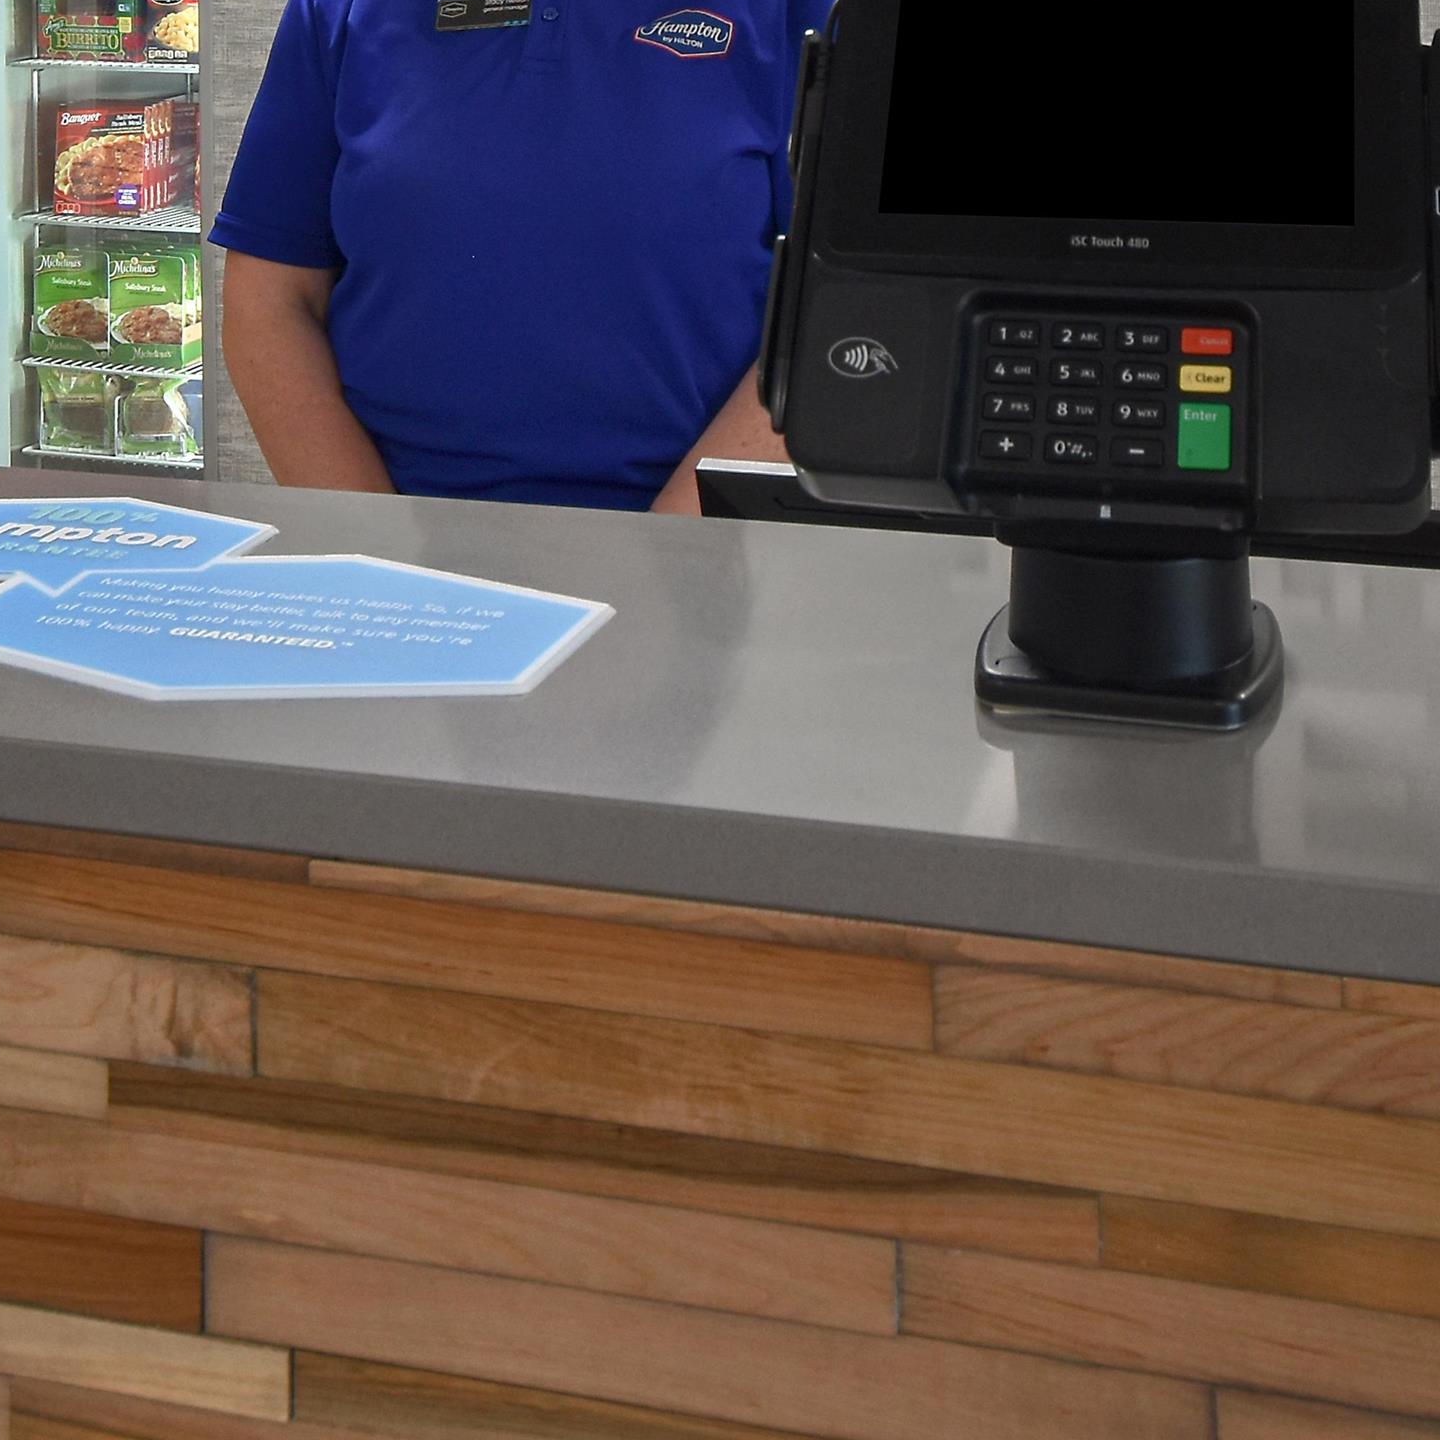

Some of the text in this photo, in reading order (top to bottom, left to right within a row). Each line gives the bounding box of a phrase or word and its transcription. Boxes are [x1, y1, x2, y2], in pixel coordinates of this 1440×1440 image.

[641, 21, 728, 43] Hampton
[57, 32, 119, 50] BURRITO
[61, 112, 102, 126] Banquet
[1091, 236, 1124, 247] Touch
[1000, 327, 1007, 340] 1
[1062, 328, 1098, 342] 2 ABC
[1124, 331, 1159, 345] 3 DEF
[994, 362, 1031, 376] 4 GHI
[1060, 365, 1070, 379] 5
[1122, 368, 1160, 382] 6 MNO
[1195, 372, 1225, 384] Clear
[992, 398, 1003, 413] 7
[1057, 402, 1094, 416] 8 TUV
[1120, 405, 1159, 419] 9 WXY
[1184, 409, 1218, 422] Enter
[27, 504, 160, 525] 100%
[100, 577, 167, 591] Making
[167, 583, 203, 594] you
[207, 586, 265, 600] happy
[267, 592, 325, 604] makes
[330, 597, 350, 605] us
[423, 603, 448, 615] So,
[456, 605, 473, 615] if
[475, 609, 505, 619] we
[78, 590, 110, 600] can
[113, 593, 162, 604] make
[163, 598, 208, 609] your
[212, 600, 250, 612] stay
[312, 609, 345, 620] talk
[350, 612, 369, 622] to
[372, 615, 408, 626] any
[410, 618, 491, 632] member
[55, 602, 473, 646] of our team, and we'll make sure you're
[36, 615, 92, 628] 100%
[97, 620, 161, 635] happy
[169, 627, 337, 650] GUARANTEED.
